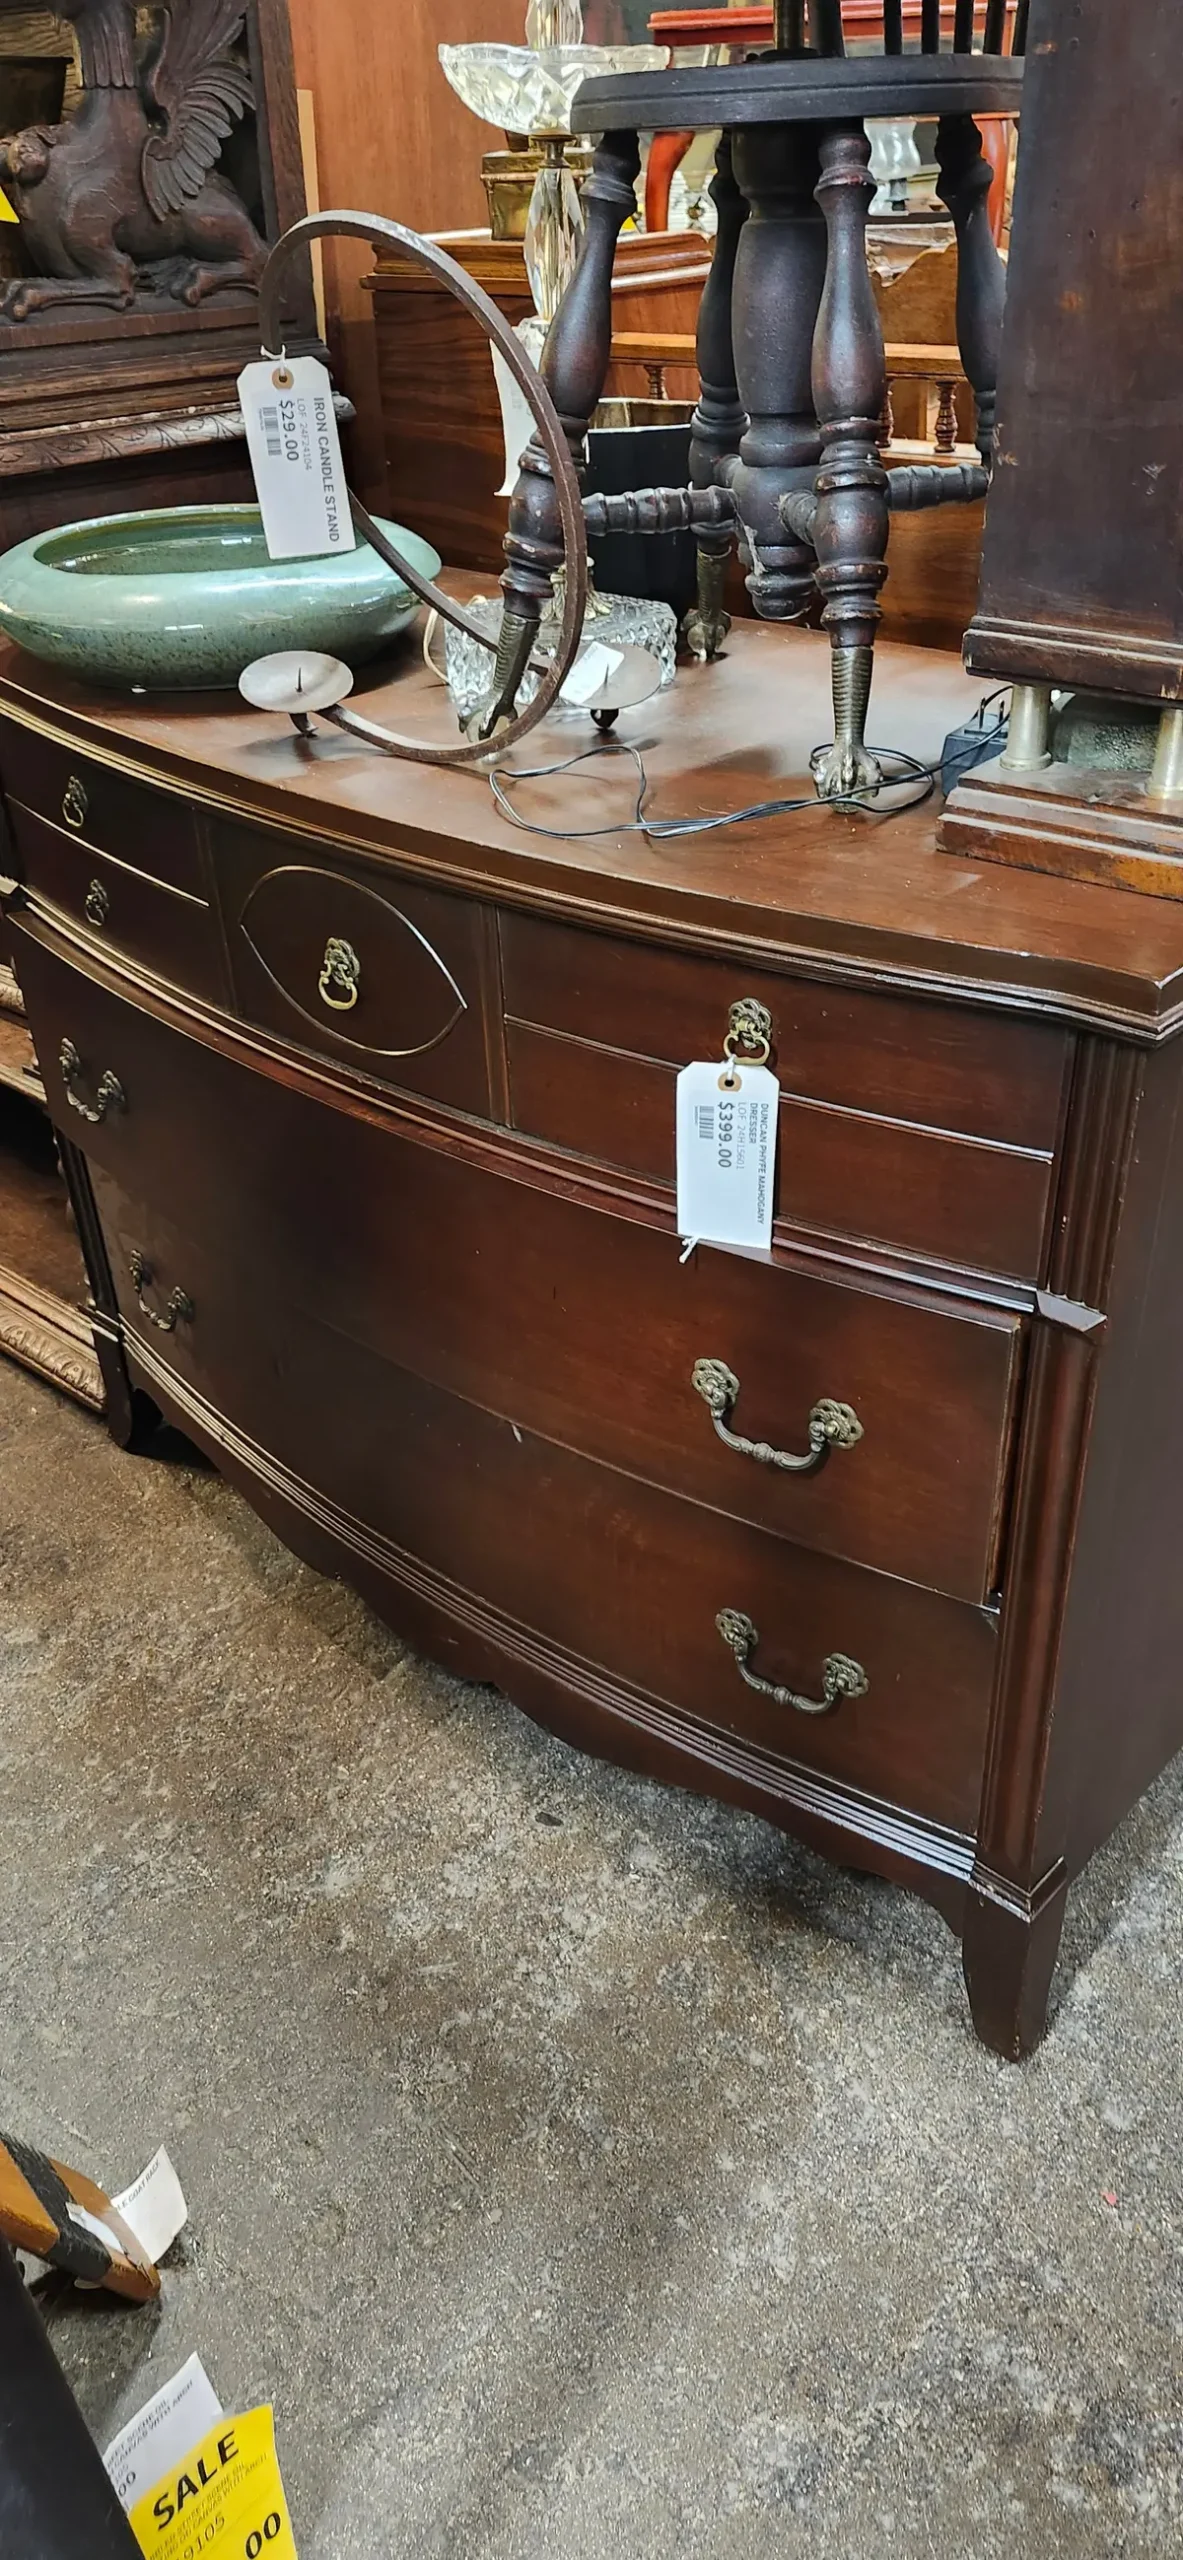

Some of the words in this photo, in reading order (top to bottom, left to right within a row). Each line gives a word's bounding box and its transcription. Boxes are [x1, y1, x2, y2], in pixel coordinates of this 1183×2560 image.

[279, 399, 300, 461] $29.00
[313, 397, 328, 432] IRON
[318, 436, 335, 493] CANDLE
[324, 495, 340, 542] STAND
[717, 1101, 733, 1168] $399.00
[748, 1102, 758, 1144] DRESSER
[759, 1103, 769, 1143] DUNCAN
[758, 1144, 767, 1173] PHYFE
[756, 1175, 766, 1225] MAHOGANY
[128, 2179, 146, 2202] COAT
[145, 2158, 160, 2182] RACK
[127, 2412, 155, 2442] SCENE
[118, 2471, 136, 2497] 00
[152, 2430, 239, 2531] SALE
[183, 2515, 225, 2560] 9105
